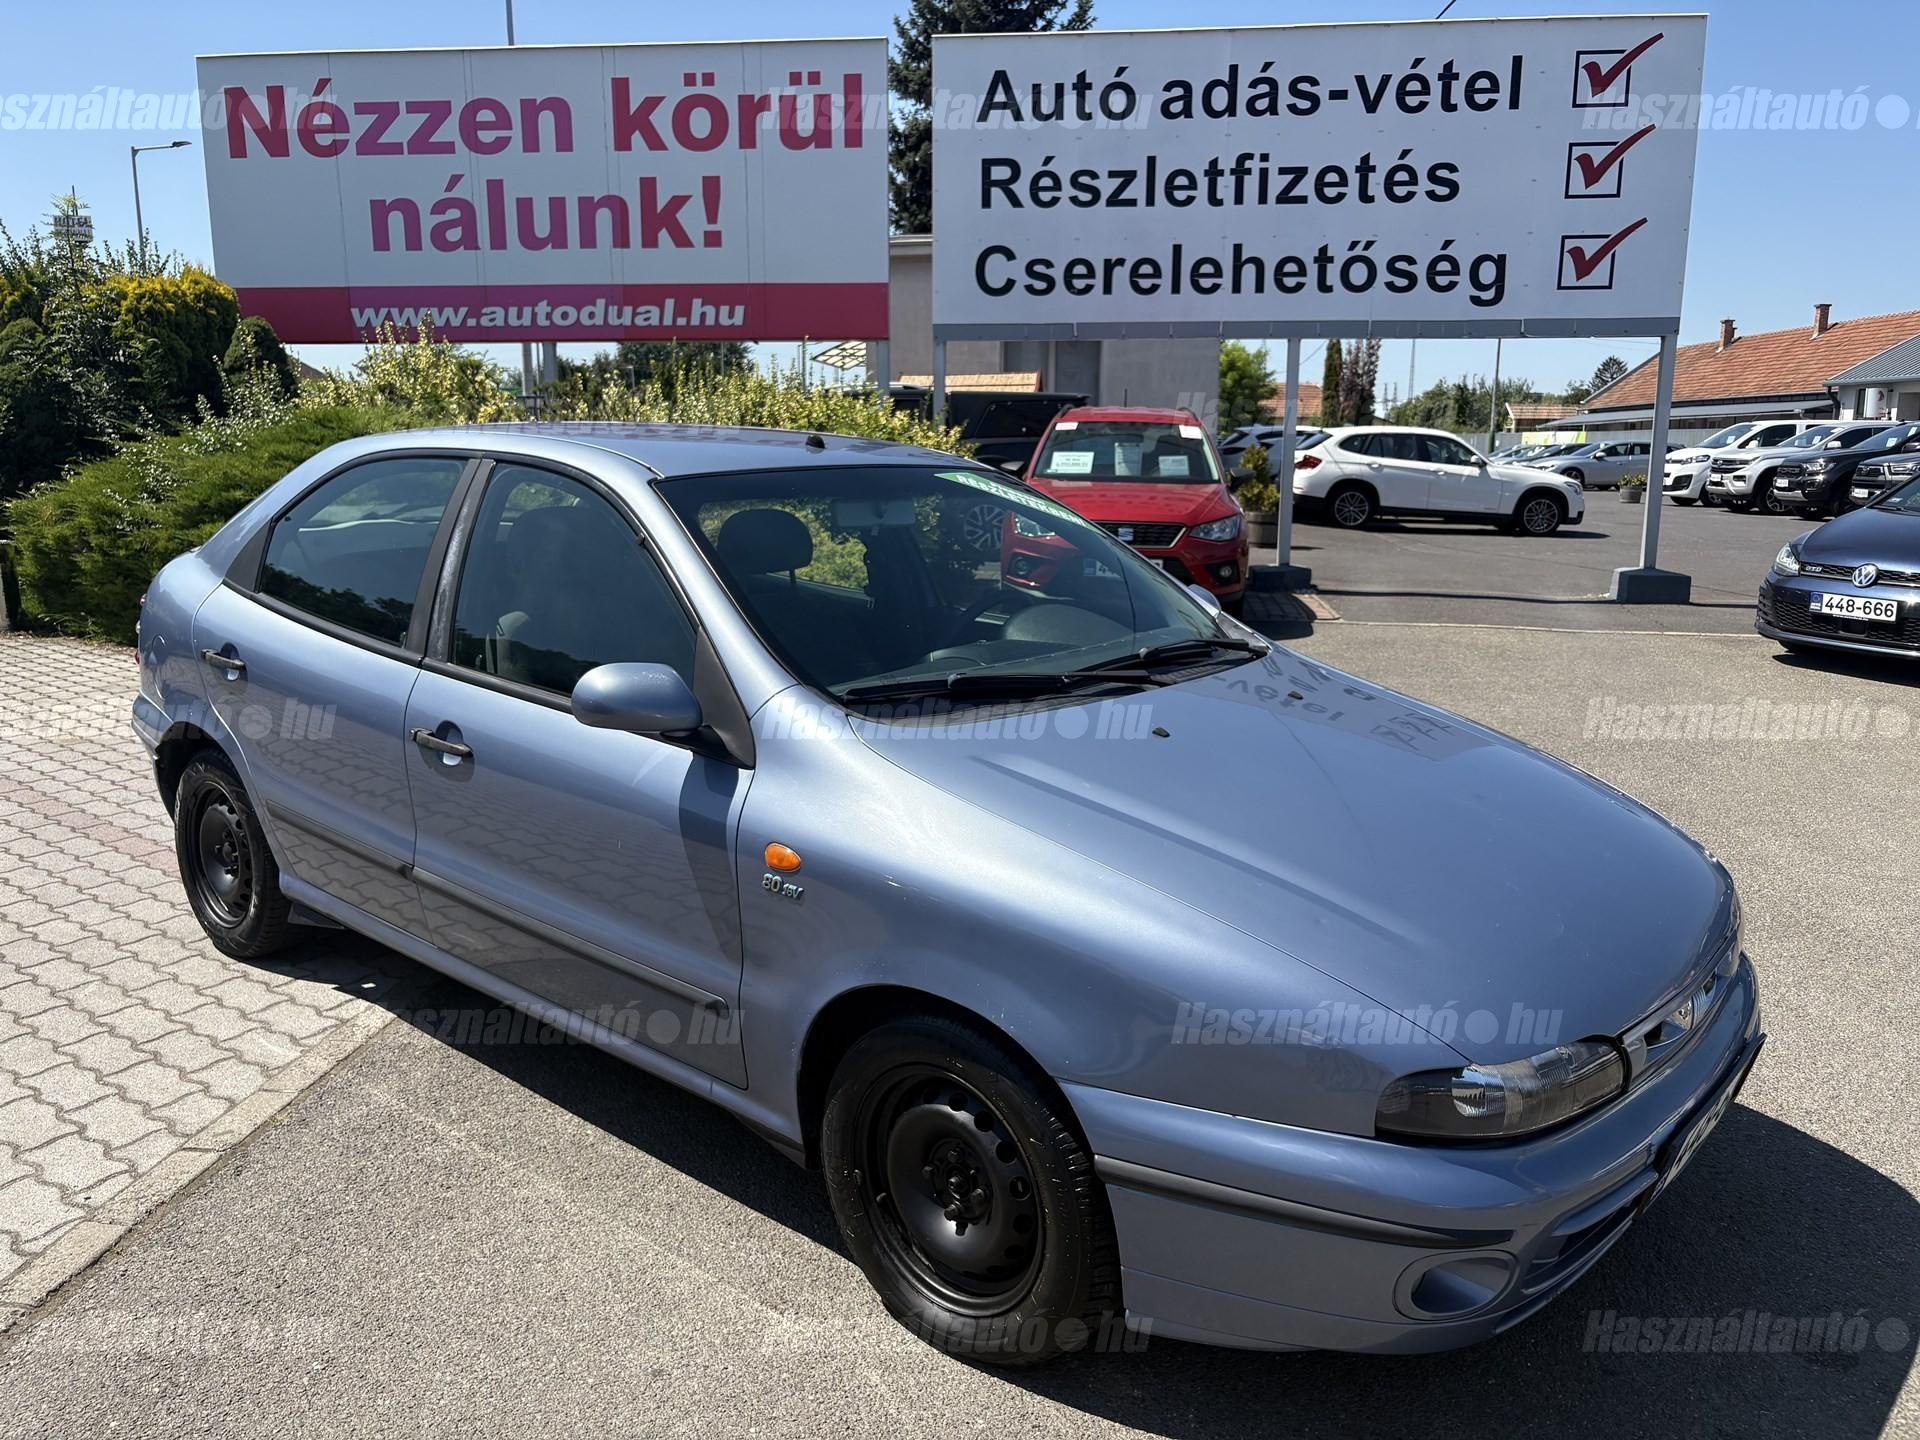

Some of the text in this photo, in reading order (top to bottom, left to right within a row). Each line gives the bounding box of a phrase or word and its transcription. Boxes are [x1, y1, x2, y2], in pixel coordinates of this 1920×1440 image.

[224, 71, 864, 159] Nézzen körül
[976, 54, 1523, 122] Autó adás-vétel
[981, 148, 1460, 209] Részletfizetés
[369, 173, 722, 252] nálunk!
[975, 238, 1507, 307] Cserelehetőség
[351, 297, 745, 330] www.autodual.hu
[1824, 596, 1895, 618] 448-666
[762, 873, 782, 892] 80
